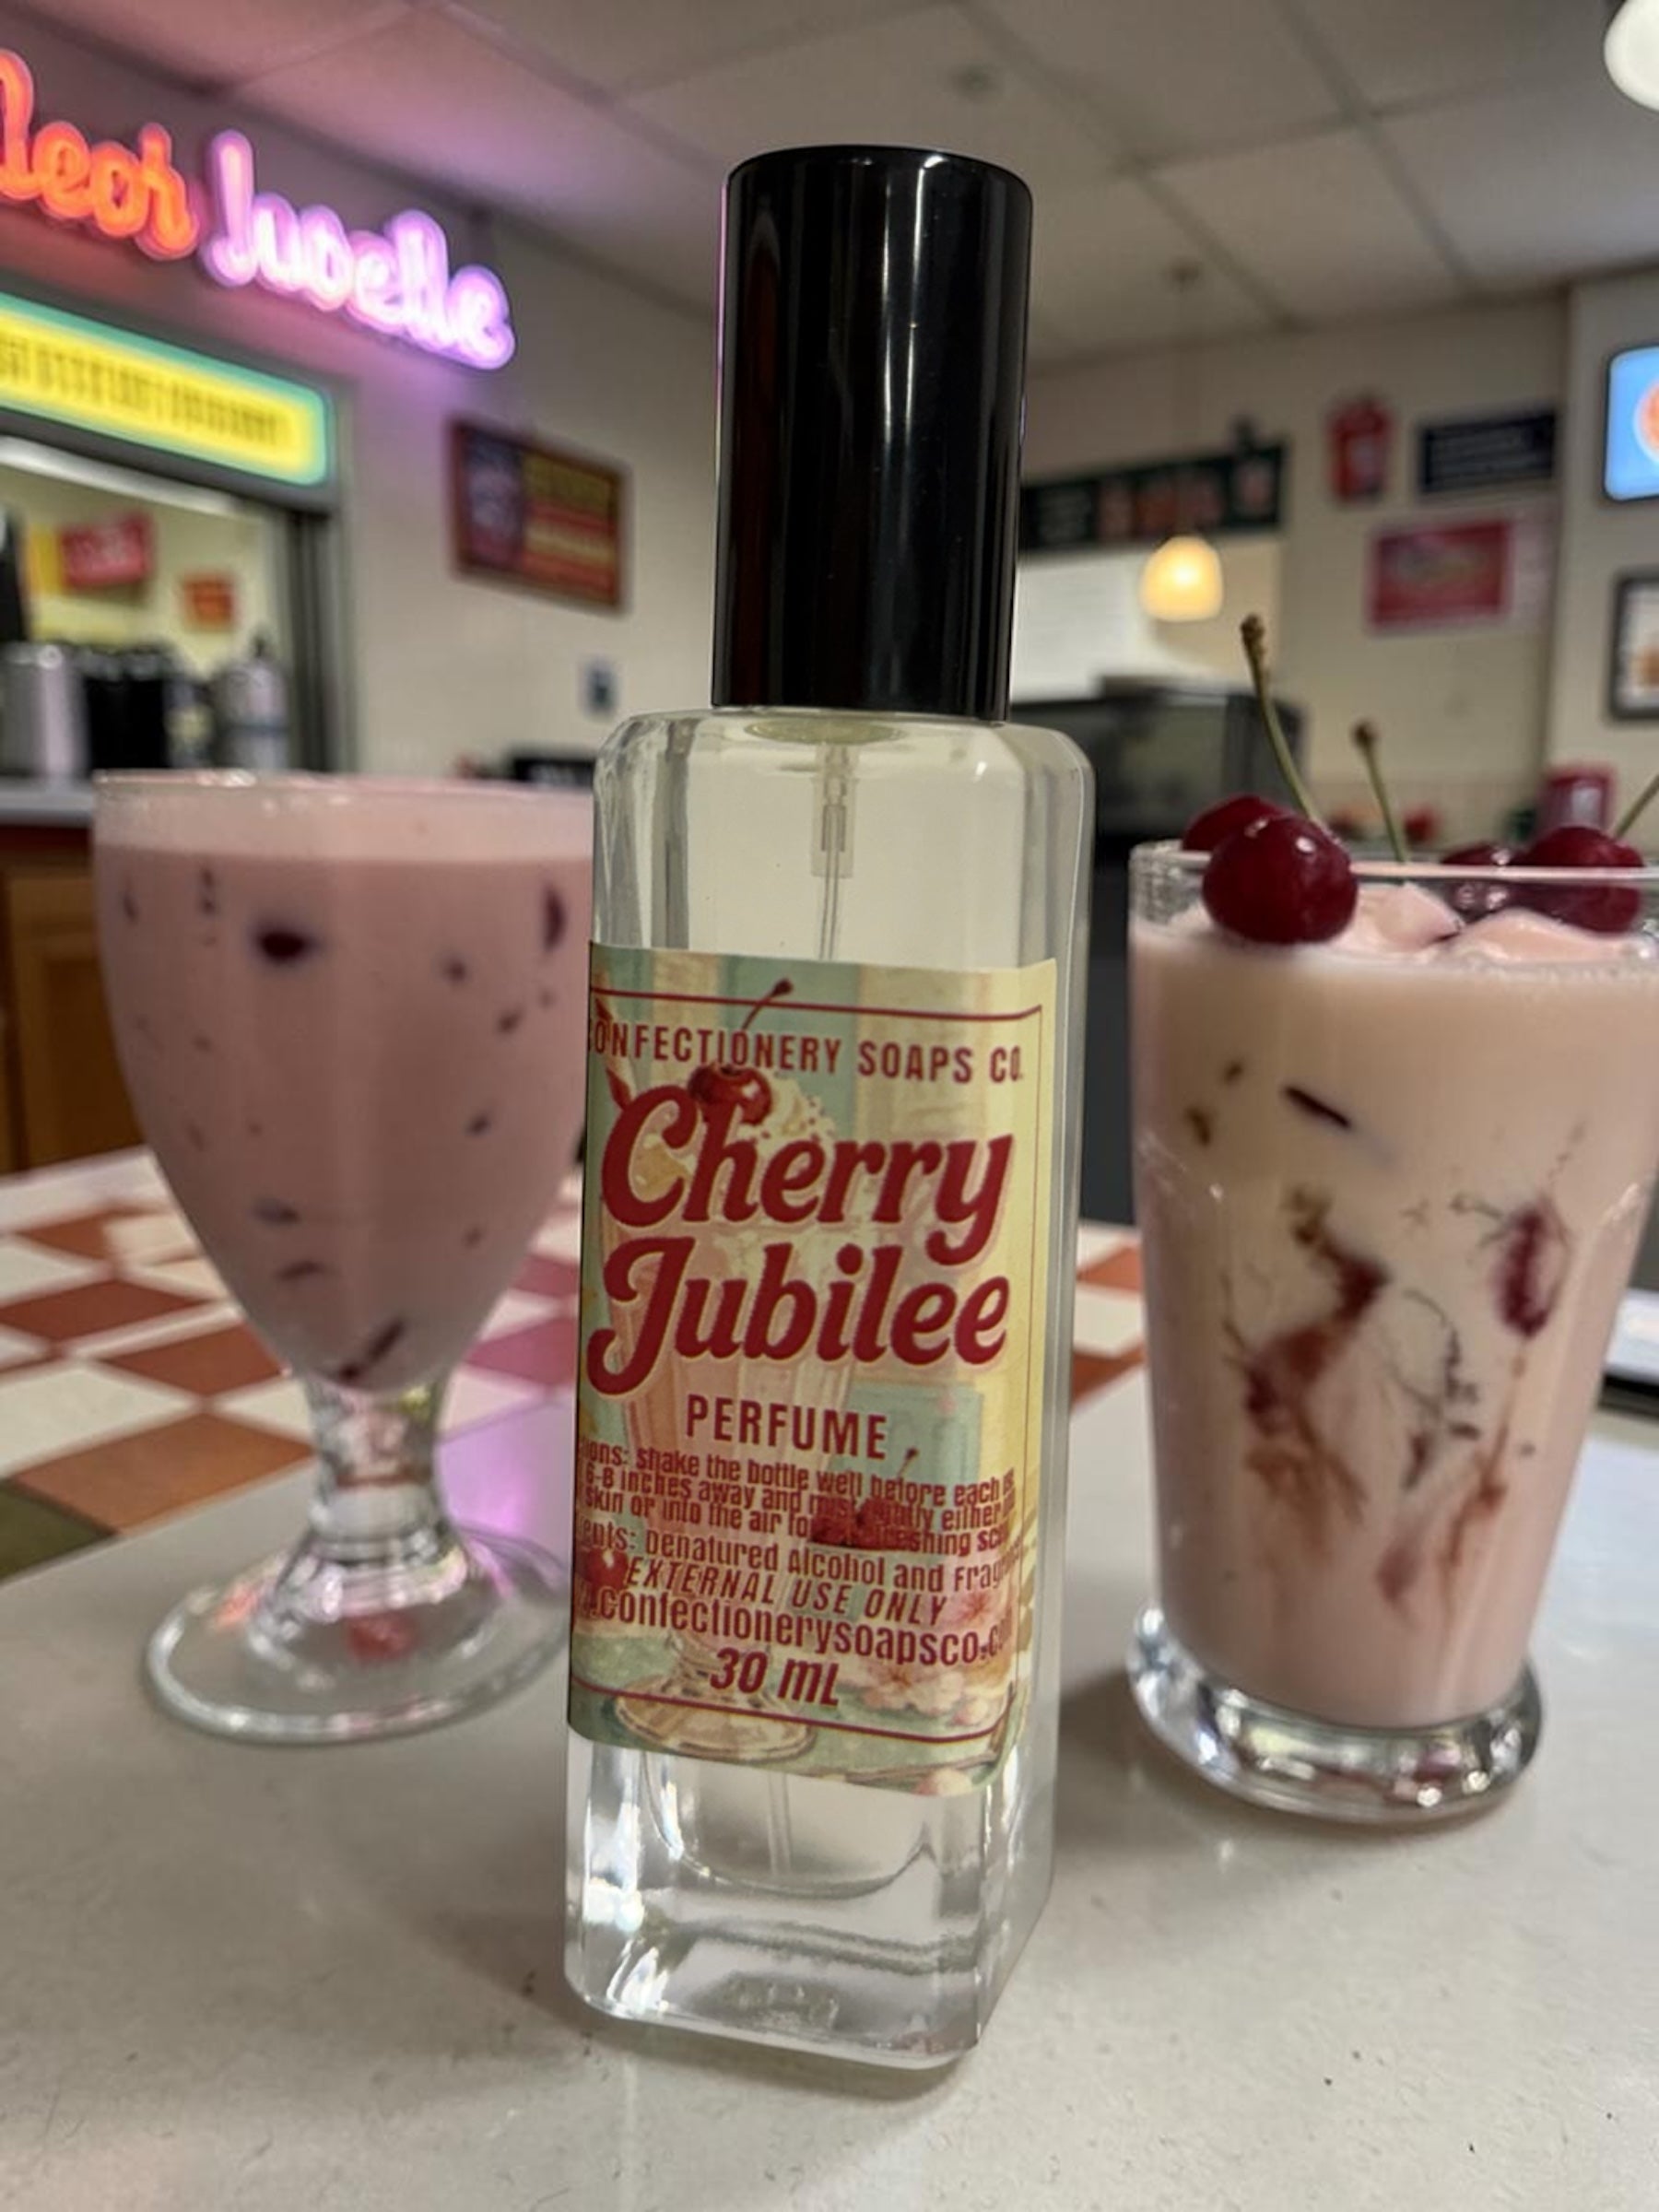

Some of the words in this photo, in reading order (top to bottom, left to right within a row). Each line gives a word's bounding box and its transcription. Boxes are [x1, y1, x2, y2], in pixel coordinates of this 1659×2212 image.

[587, 1018, 841, 1073] ONFECTIONERY
[857, 1040, 973, 1084] SOAPS
[600, 1085, 1014, 1266] Cherry
[586, 1236, 1011, 1395] Jubilee
[686, 1394, 888, 1460] PERFUME
[585, 1485, 624, 1513] skin
[630, 1494, 655, 1518] or
[662, 1497, 701, 1525] into
[708, 1500, 742, 1530] the
[748, 1510, 782, 1534] air
[788, 1512, 811, 1537] fo
[620, 1468, 691, 1500] inches
[698, 1479, 756, 1510] away
[761, 1488, 802, 1512] and
[941, 1500, 1001, 1531] either
[706, 1453, 741, 1481] the
[747, 1459, 809, 1491] bottle
[817, 1468, 863, 1498] well
[870, 1474, 946, 1507] before
[954, 1476, 1000, 1507] each
[626, 1556, 775, 1605] EXTERNAL
[792, 1579, 852, 1615] USE
[864, 1588, 947, 1626] ONLY
[646, 1528, 778, 1571] Denatured
[788, 1547, 885, 1586] Alcohol
[893, 1562, 944, 1593] and
[709, 1647, 770, 1694] 30
